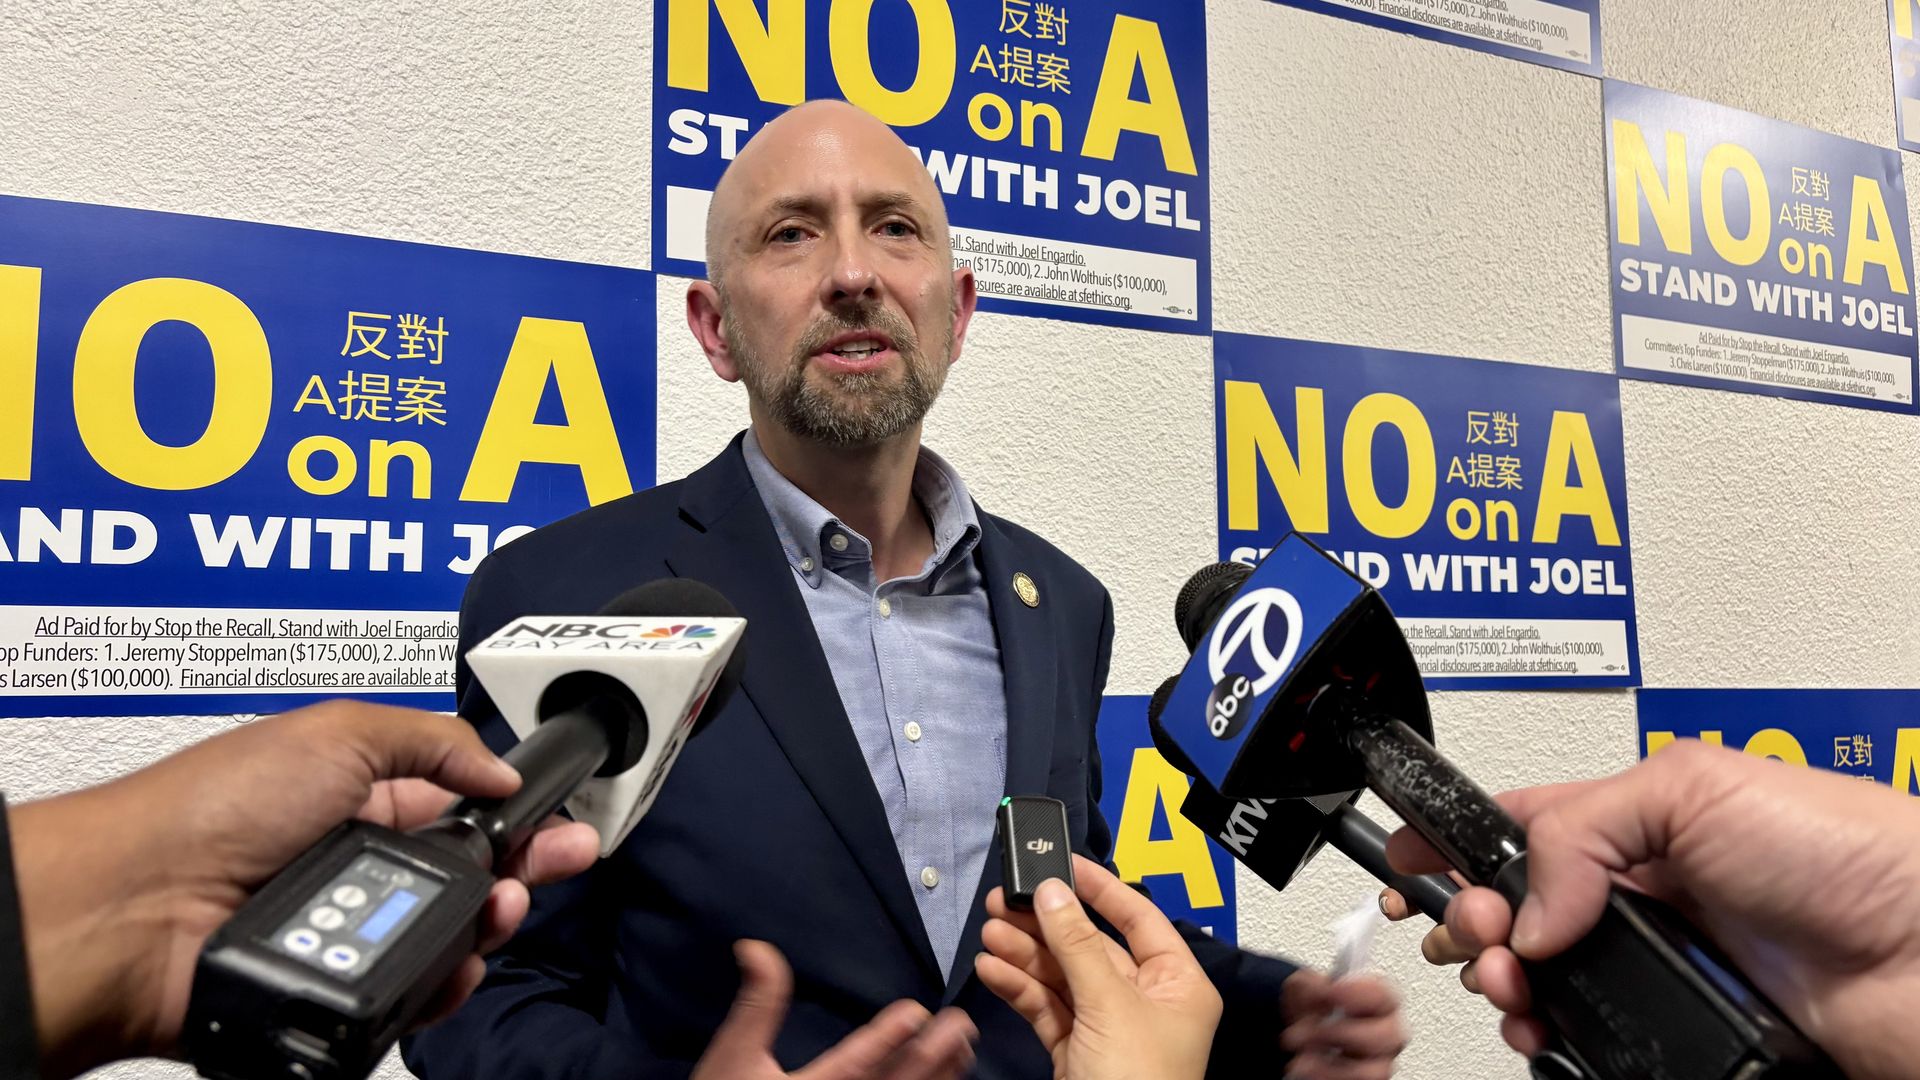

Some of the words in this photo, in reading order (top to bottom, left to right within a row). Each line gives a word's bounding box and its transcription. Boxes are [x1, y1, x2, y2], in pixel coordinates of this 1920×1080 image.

[999, 0, 1070, 46] 反對
[667, 0, 956, 127] NO
[967, 92, 1063, 152] on
[1080, 13, 1197, 176] A
[969, 43, 1071, 94] A提案
[667, 108, 771, 159] ST
[911, 147, 1058, 210] WITH
[1074, 173, 1200, 231] JOEL
[1790, 166, 1831, 201] 反對
[1612, 118, 1771, 267] NO
[1778, 237, 1833, 282] on
[1843, 174, 1909, 296] A
[1778, 202, 1835, 238] A提案
[966, 235, 994, 254] Stand
[996, 239, 1018, 256] with
[1018, 242, 1039, 260] Joel
[1041, 246, 1086, 266] Engardio.
[972, 256, 1032, 278] ($175,000),
[1034, 263, 1043, 279] 2.
[1044, 264, 1069, 281] John
[1070, 269, 1113, 288] Wolthuis
[1113, 273, 1168, 295] ($100,000),
[1007, 284, 1022, 295] are
[1024, 282, 1066, 300] available
[1068, 288, 1078, 300] at
[1078, 287, 1132, 310] sfethics.org.
[1620, 258, 1737, 307] STAND
[1747, 279, 1833, 325] WITH
[1841, 295, 1913, 337] JOEL
[340, 310, 449, 366] 反對
[287, 434, 432, 500] on
[459, 316, 634, 507] A
[293, 371, 448, 426] A提案
[1466, 410, 1520, 447] 反對
[1224, 379, 1436, 539] NO
[1446, 497, 1519, 542] on
[1531, 410, 1622, 546] A
[1446, 453, 1523, 490] A提案
[0, 506, 158, 566] ND
[188, 513, 424, 572] WITH
[1402, 552, 1518, 593] WITH
[1529, 557, 1627, 596] JOEL
[35, 615, 58, 635] Ad
[64, 616, 100, 636] Paid
[104, 616, 128, 636] for
[131, 616, 152, 641] by
[154, 617, 192, 641] Stop
[196, 617, 222, 636] the
[226, 618, 276, 639] Recall,
[279, 618, 322, 638] Stand
[326, 618, 358, 638] with
[360, 620, 391, 638] Joel
[487, 640, 574, 650] BAY
[584, 640, 704, 650] AREA
[504, 623, 641, 638] NBC
[24, 642, 98, 662] Funders:
[104, 643, 118, 662] 1.
[120, 643, 186, 667] Jeremy
[188, 642, 286, 667] Stoppelman
[290, 643, 380, 664] ($175,000),
[384, 644, 397, 662] 2.
[398, 644, 436, 662] John
[12, 669, 67, 688] Larsen
[71, 667, 173, 691] ($100,000).
[181, 668, 250, 687] Financial
[255, 666, 338, 687] disclosures
[342, 671, 365, 686] are
[368, 666, 432, 686] available
[434, 670, 448, 685] at
[1210, 675, 1250, 738] abc
[1834, 734, 1872, 767] 反對
[1026, 838, 1054, 854] dji
[1111, 748, 1224, 909] A
[1219, 798, 1277, 856] KTV
